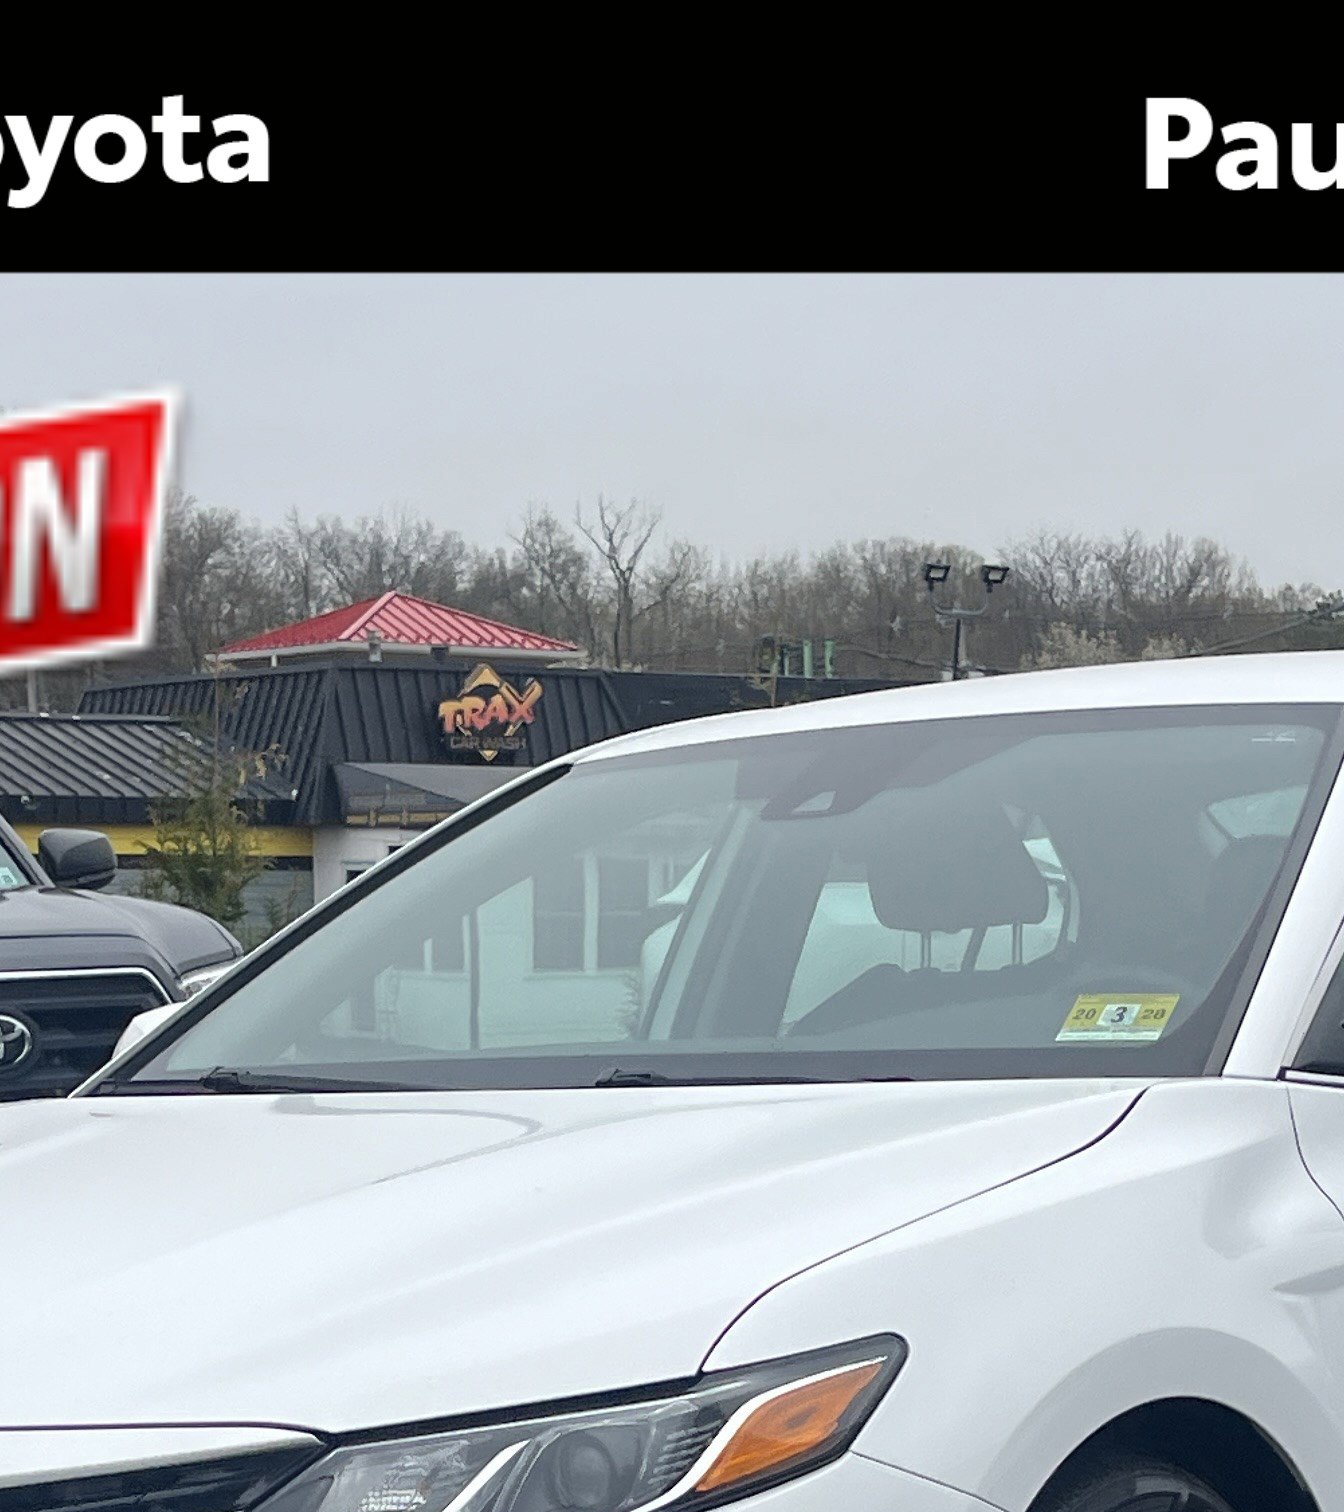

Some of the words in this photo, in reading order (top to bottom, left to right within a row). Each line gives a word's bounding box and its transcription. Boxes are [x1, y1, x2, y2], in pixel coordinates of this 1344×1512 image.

[439, 677, 543, 733] TRAX
[451, 737, 480, 750] CAR
[483, 737, 527, 750] WASH
[1071, 1008, 1097, 1021] 20
[1110, 1006, 1128, 1023] 3
